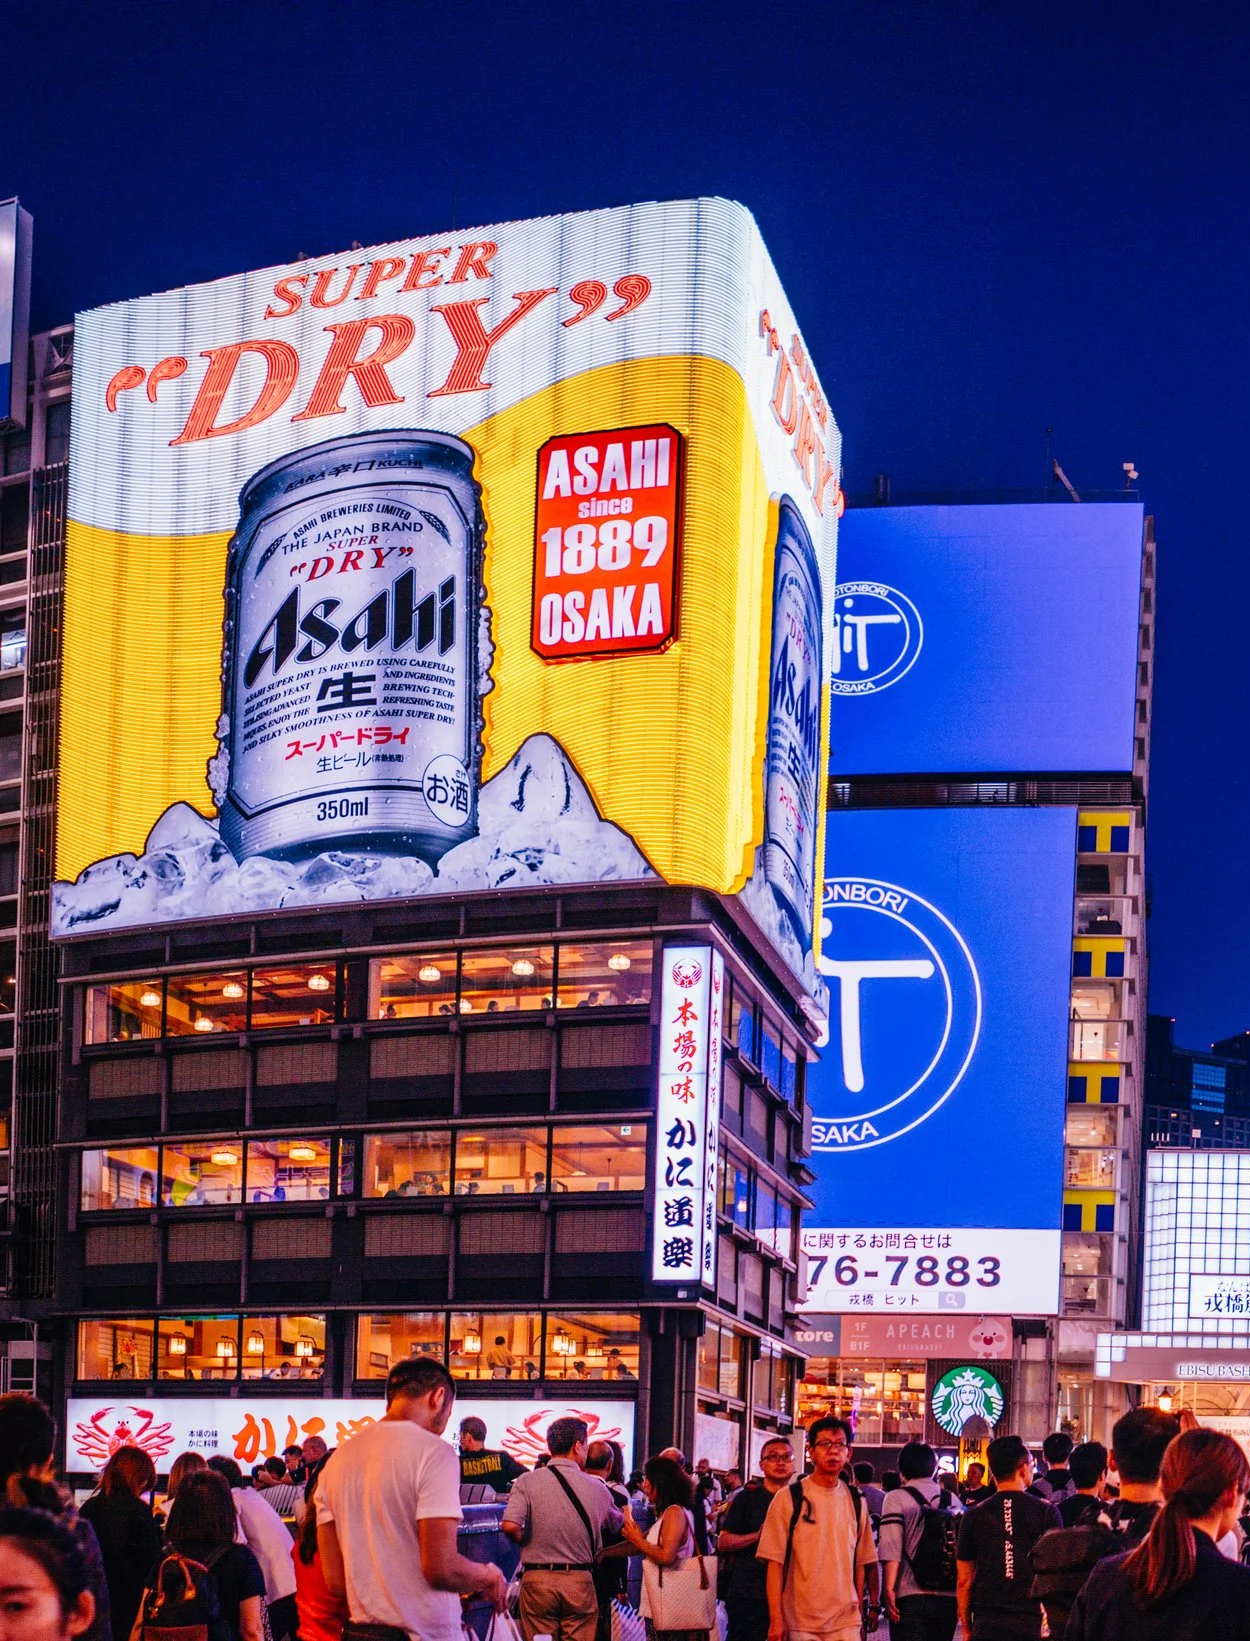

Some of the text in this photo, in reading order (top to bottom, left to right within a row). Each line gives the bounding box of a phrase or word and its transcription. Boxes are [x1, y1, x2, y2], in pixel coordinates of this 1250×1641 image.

[264, 241, 499, 319] SUPER
[329, 460, 375, 478] 辛口
[376, 458, 425, 470] KUCHI
[542, 437, 670, 500] ASAHI
[282, 471, 326, 494] KARA
[578, 495, 633, 519] since
[293, 503, 412, 540] ASAHI BREWERIES LIMITED
[282, 521, 424, 555] THE JAPAN BRAND
[326, 535, 379, 552] SUPER
[541, 515, 669, 578] 1889
[539, 582, 664, 647] OSAKA
[243, 567, 457, 690] Asahi
[244, 658, 456, 704] ASAHI SUPER DRY IS BREWED USING CAREFULLY
[283, 682, 312, 697] YEAST
[383, 670, 403, 679] AND
[404, 671, 456, 687] INGREDIENTS
[316, 671, 378, 713] 生
[832, 682, 876, 693] OSAKA
[267, 696, 455, 727] ENJOY THE REFRESHING TASTE
[273, 695, 311, 714] ADVANCED
[383, 684, 430, 694] BREWING
[432, 687, 455, 699] TECH-
[259, 728, 284, 745] SILKY
[284, 711, 353, 734] SMOOTHNESS
[355, 710, 371, 719] OF
[372, 709, 404, 718] ASAHI
[405, 709, 435, 721] SUPER
[285, 727, 411, 761] スーパードライ
[426, 773, 470, 816] お酒
[316, 796, 369, 822] 350ml
[671, 998, 699, 1105] 本場の味
[803, 1232, 953, 1250] に関するお問合せは
[848, 1293, 920, 1306] 戎橋 ヒット
[853, 1321, 868, 1332] 1F
[886, 1323, 956, 1339] APEACH
[849, 1341, 871, 1351] B1F
[1178, 1363, 1214, 1377] EBISU
[188, 1429, 218, 1439] 本場の味
[188, 1439, 219, 1449] かに料理
[463, 1455, 502, 1476] BASKETBALL
